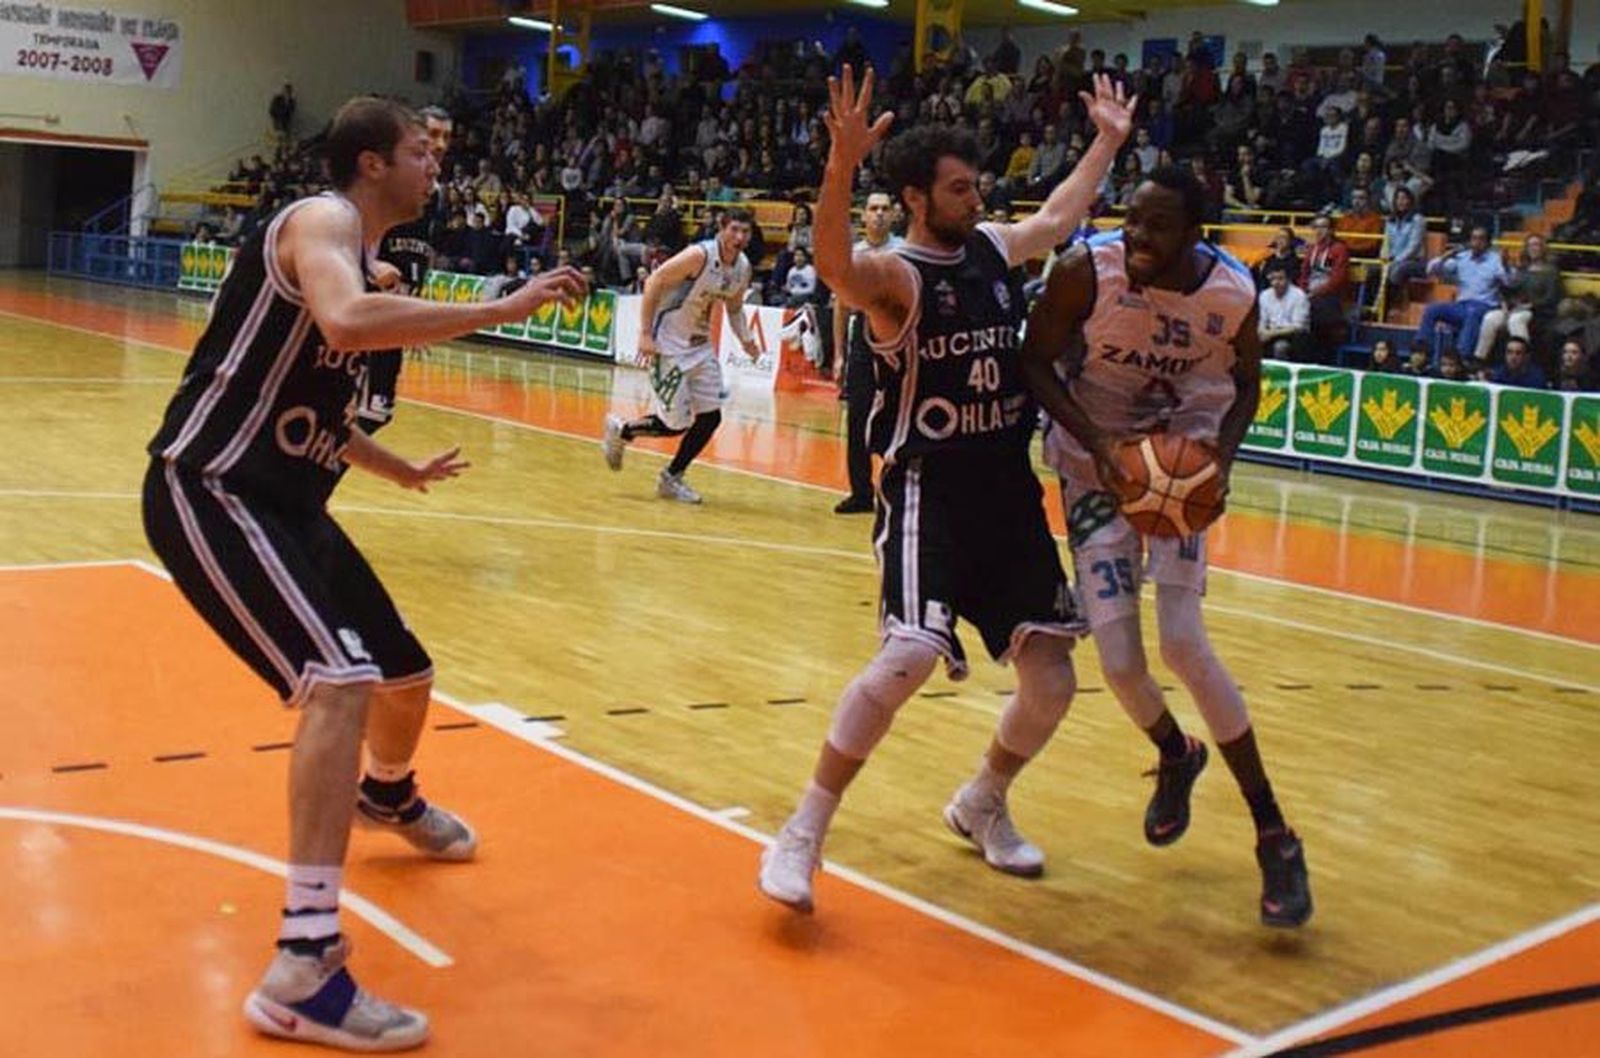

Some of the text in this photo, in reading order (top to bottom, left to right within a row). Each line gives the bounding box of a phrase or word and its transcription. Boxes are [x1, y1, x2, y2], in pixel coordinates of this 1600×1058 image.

[34, 33, 100, 50] TEMPORADA
[17, 50, 114, 76] 2007-2008
[1152, 313, 1191, 348] 35
[967, 357, 1000, 392] 40
[1090, 558, 1135, 599] 35
